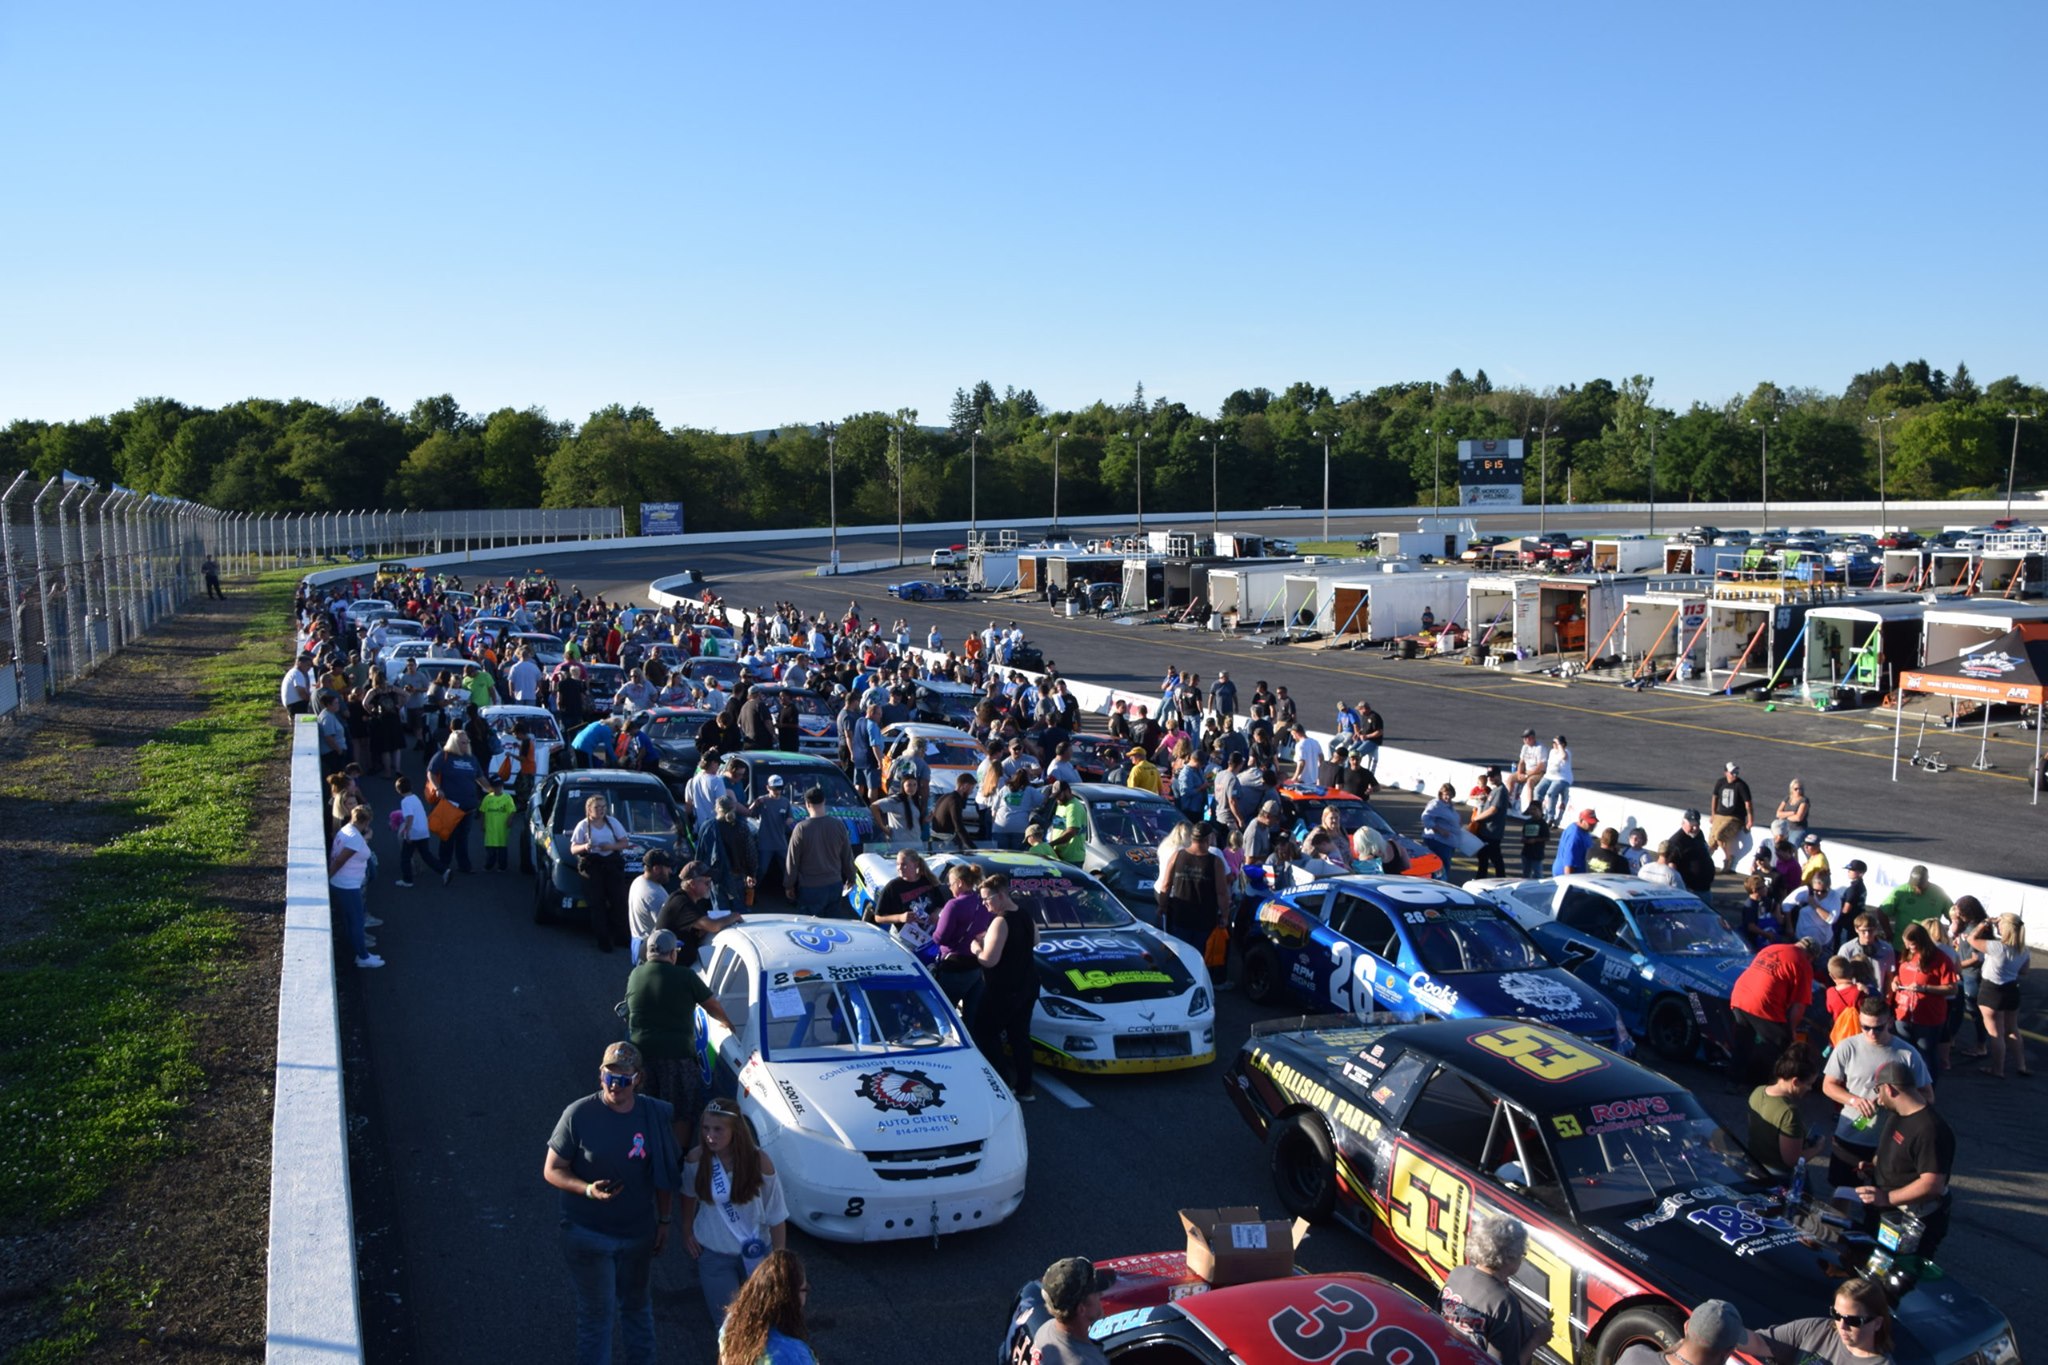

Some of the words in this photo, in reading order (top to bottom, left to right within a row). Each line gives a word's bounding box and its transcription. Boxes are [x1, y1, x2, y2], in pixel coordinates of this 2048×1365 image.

[1684, 604, 1705, 616] 113
[1776, 609, 1791, 630] 55
[1404, 911, 1425, 924] 26
[786, 925, 852, 953] 8
[1557, 940, 1600, 973] 7
[774, 972, 789, 985] 8
[827, 963, 904, 974] Somerset
[829, 971, 874, 981] Trust
[1293, 962, 1315, 980] RPM
[1329, 941, 1377, 1022] 26
[1409, 971, 1459, 1006] Cook's
[1128, 1024, 1179, 1033] CORVETTE
[1470, 1025, 1606, 1081] 53
[819, 1060, 887, 1081] CONEMAUGH
[891, 1059, 952, 1070] TOWNSHIP
[1272, 1061, 1335, 1112] COLLISION
[1333, 1099, 1382, 1141] PARTS
[1591, 1096, 1670, 1123] RON'S
[877, 1118, 910, 1128] AUTO
[913, 1115, 957, 1125] CENTER
[1552, 1114, 1583, 1138] 53
[712, 1163, 727, 1195] DAIRY
[722, 1201, 740, 1223] MISS
[848, 1197, 865, 1218] 8
[1389, 1144, 1470, 1272] 53
